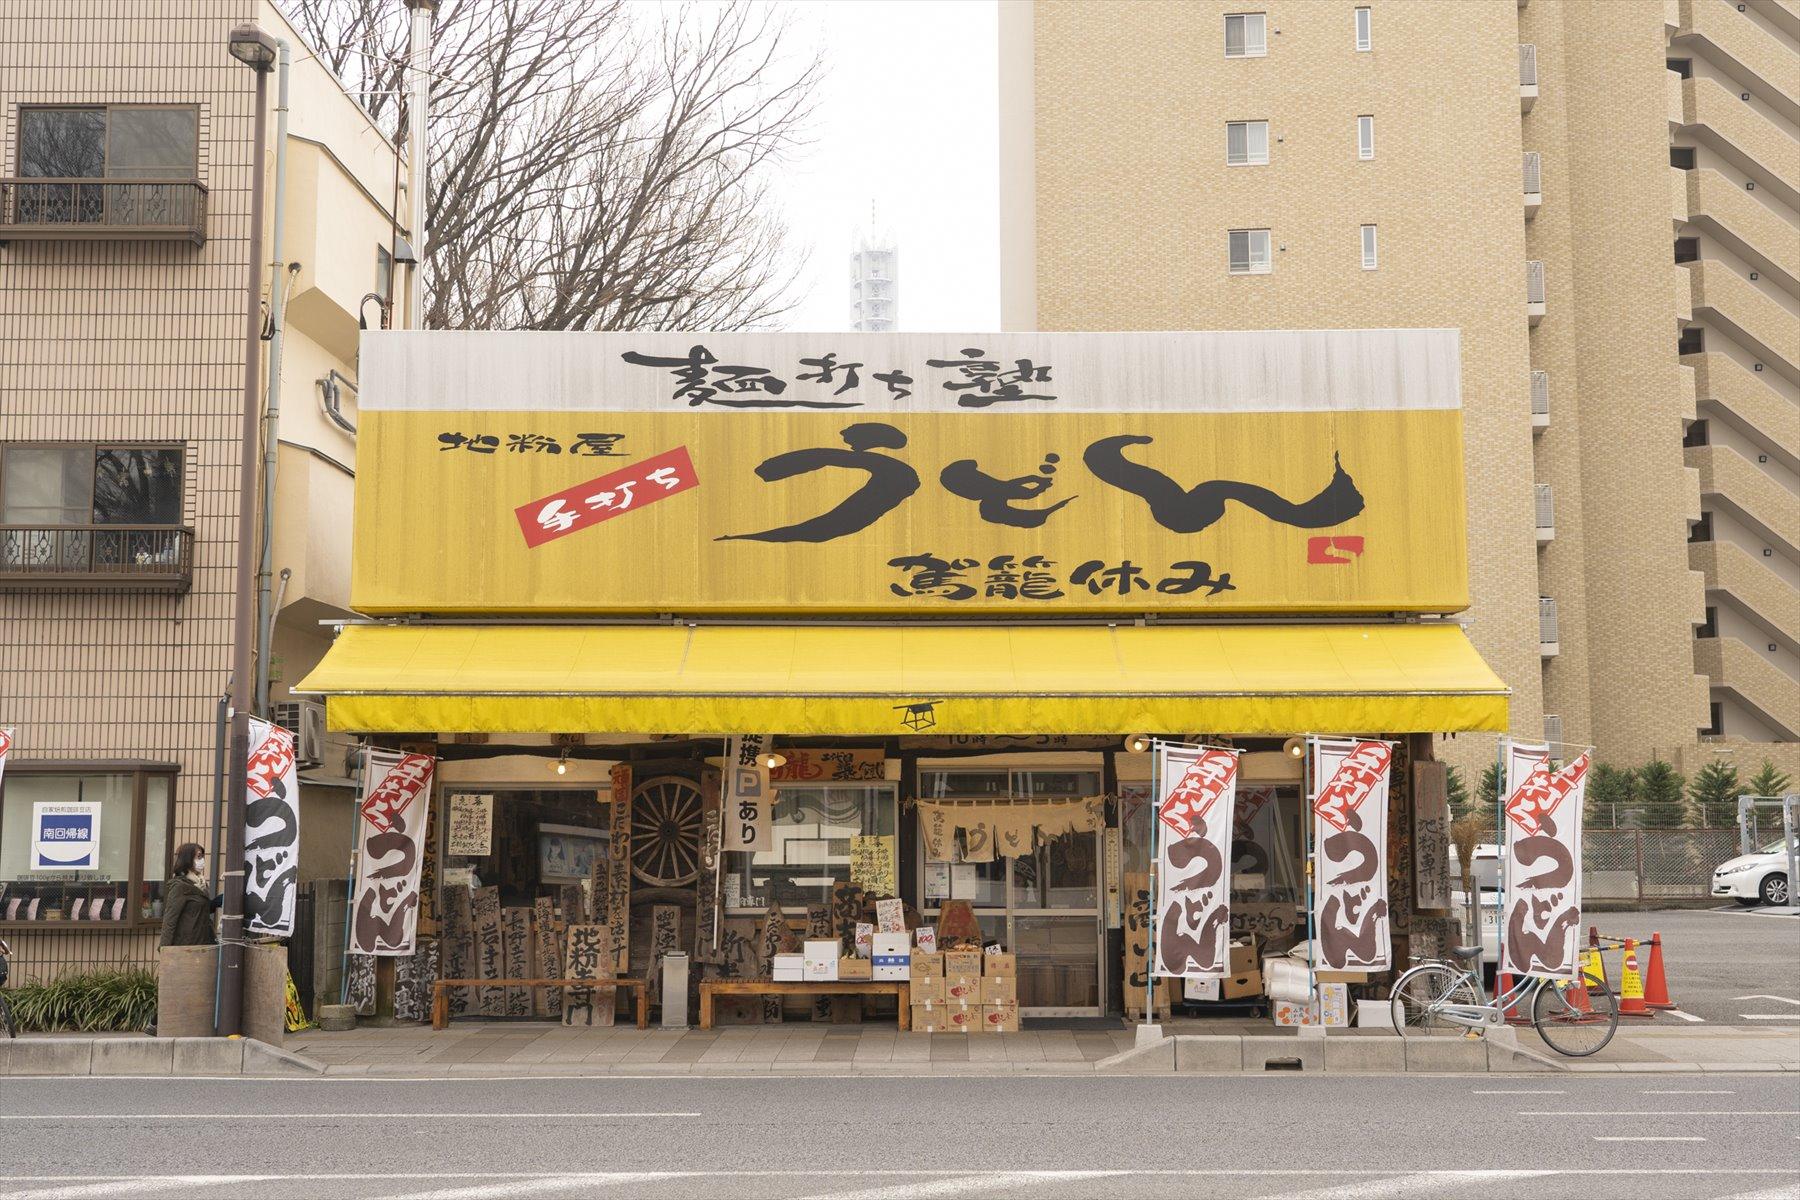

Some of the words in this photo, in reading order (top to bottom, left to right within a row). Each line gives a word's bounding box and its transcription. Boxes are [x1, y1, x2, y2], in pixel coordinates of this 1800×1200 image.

[621, 345, 1057, 408] 麺打ち塾
[437, 432, 632, 457] 地粉屋
[536, 467, 680, 533] 手打ち
[714, 422, 1366, 544] うどん
[43, 827, 89, 840] 南回帰線
[355, 812, 418, 953] うどん
[1320, 808, 1388, 969] うどん
[1508, 813, 1580, 973] うどん
[1160, 815, 1229, 975] うどん
